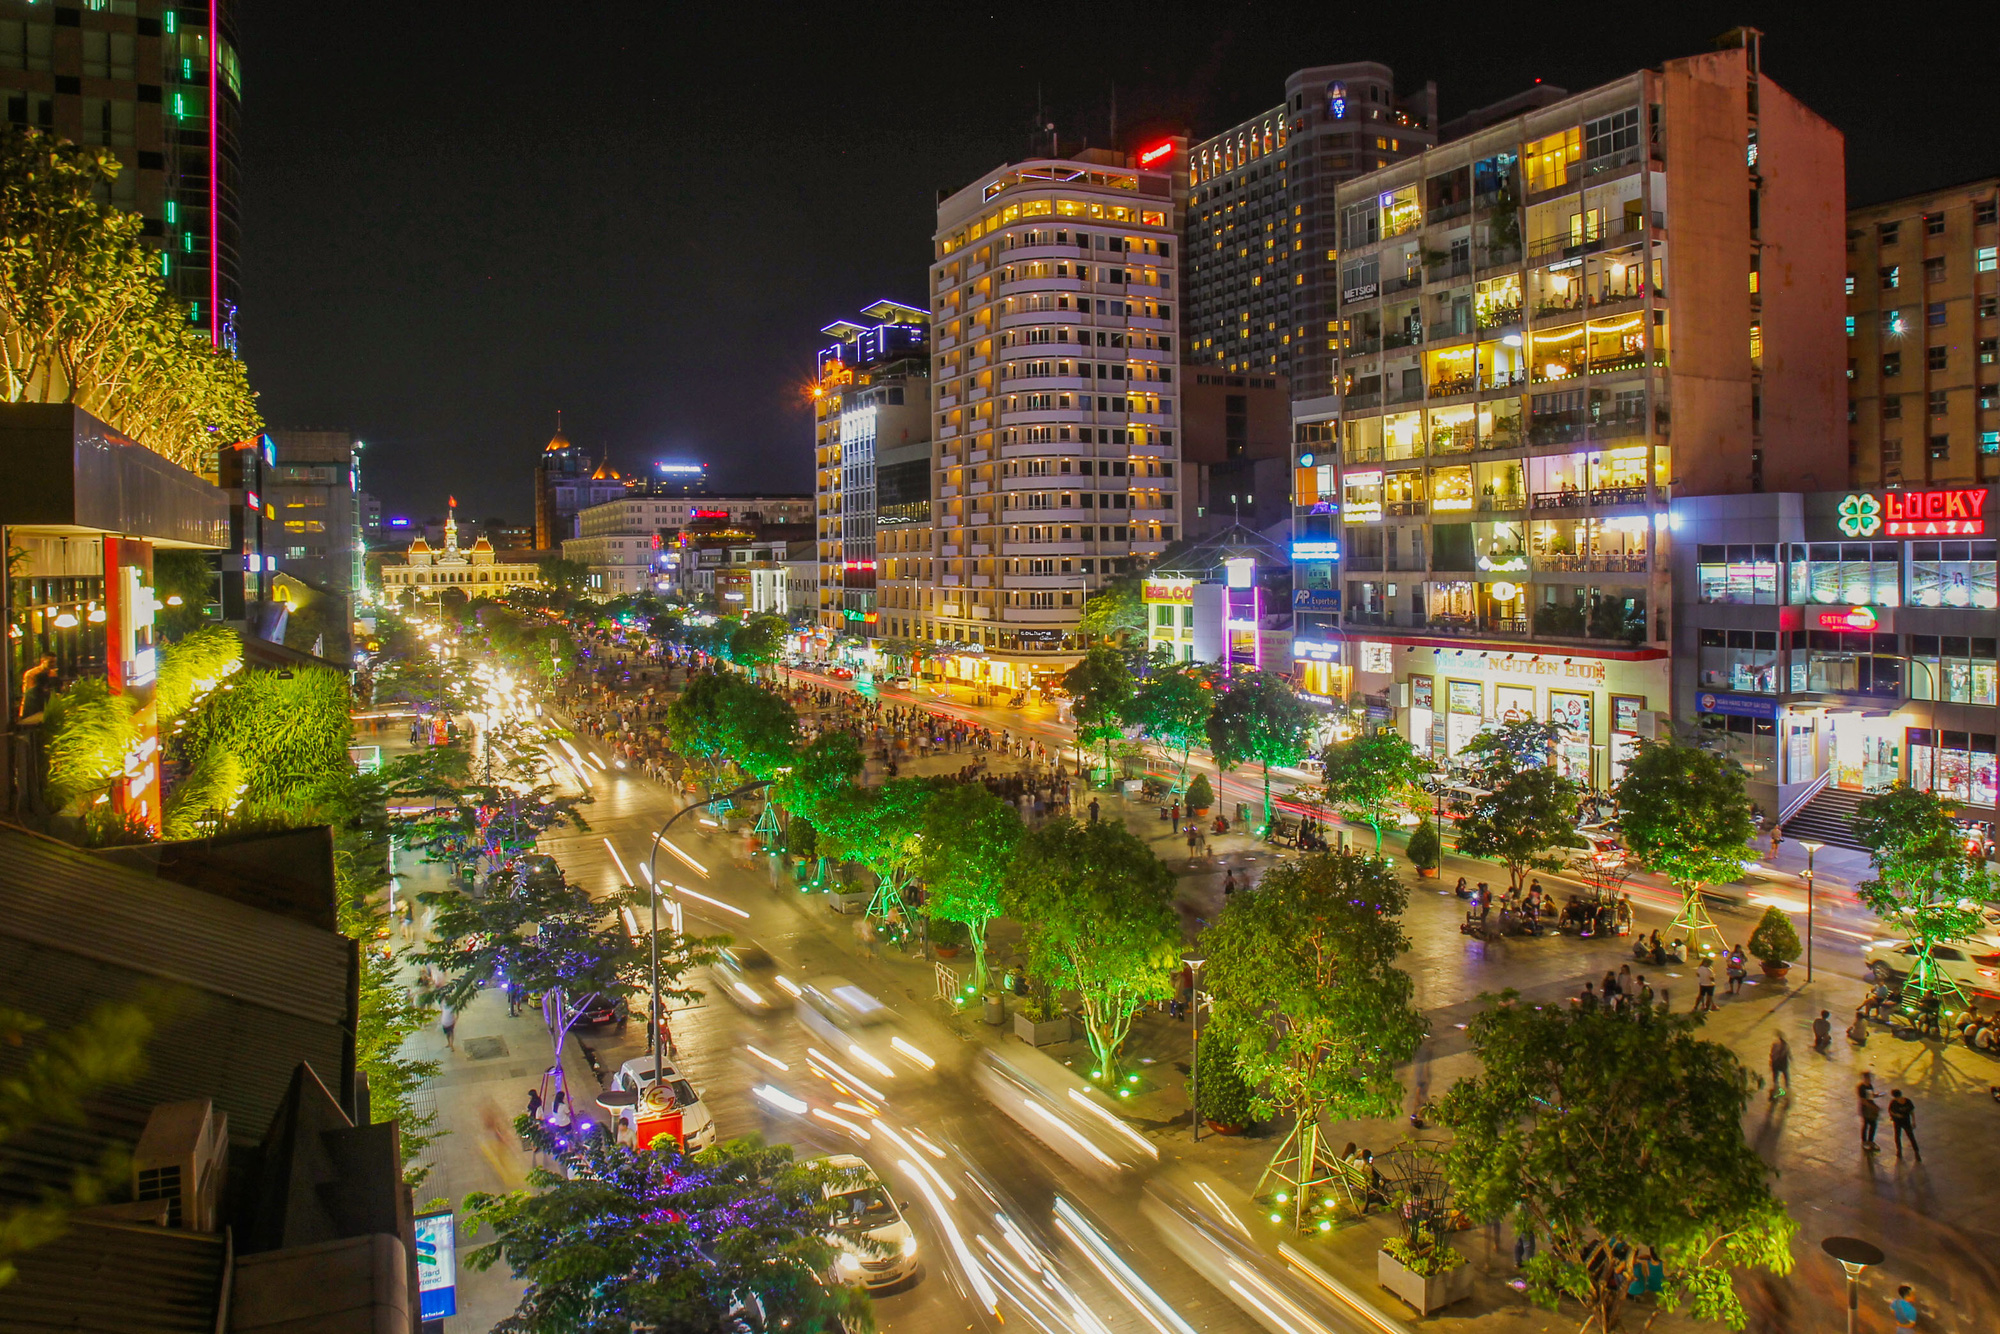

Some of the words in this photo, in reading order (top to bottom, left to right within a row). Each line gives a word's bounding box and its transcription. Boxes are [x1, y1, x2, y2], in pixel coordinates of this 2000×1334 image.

[1885, 489, 1988, 519] LUCKY
[1889, 521, 1976, 535] PLAZA
[1311, 597, 1338, 605] Expertise
